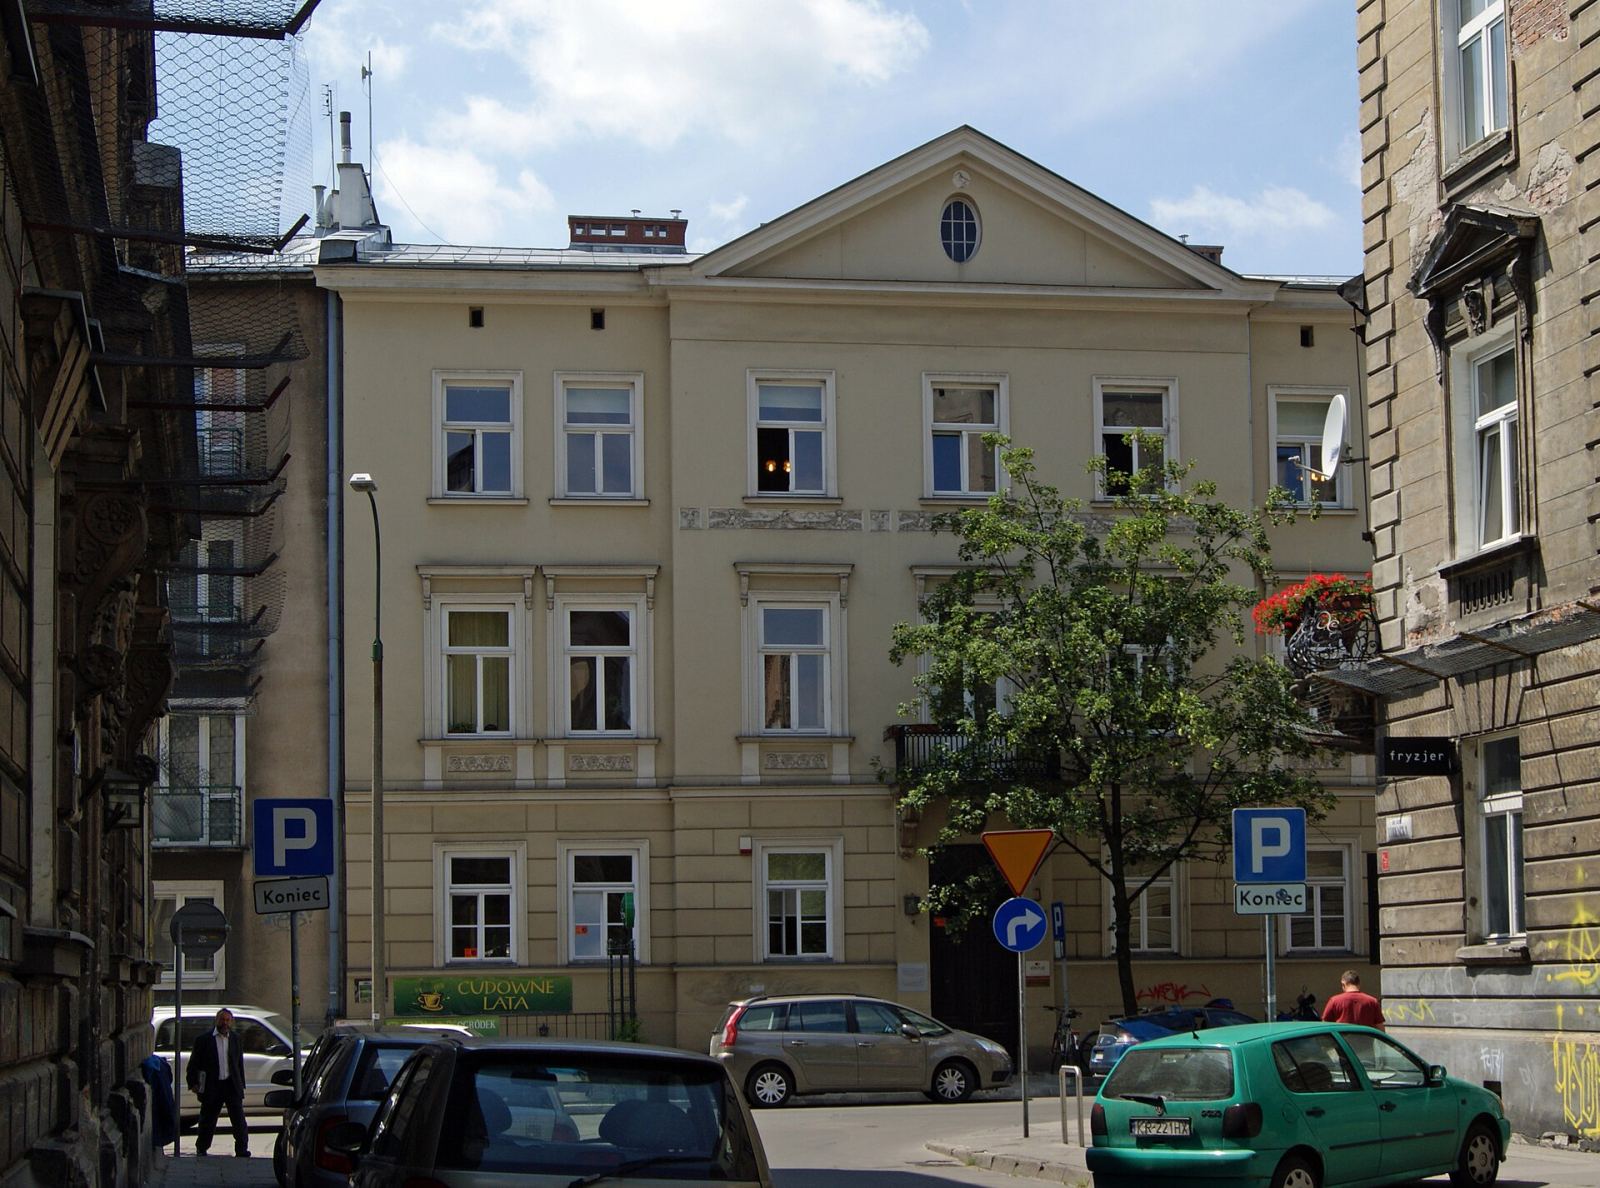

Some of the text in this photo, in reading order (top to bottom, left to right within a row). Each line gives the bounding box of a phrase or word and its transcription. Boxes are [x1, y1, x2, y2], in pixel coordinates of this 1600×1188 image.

[1390, 750, 1444, 763] fryzjer
[272, 807, 318, 867] P
[1251, 817, 1291, 873] P
[263, 888, 321, 905] Koniec
[457, 980, 555, 995] CUDOWNE
[483, 996, 529, 1011] LATA
